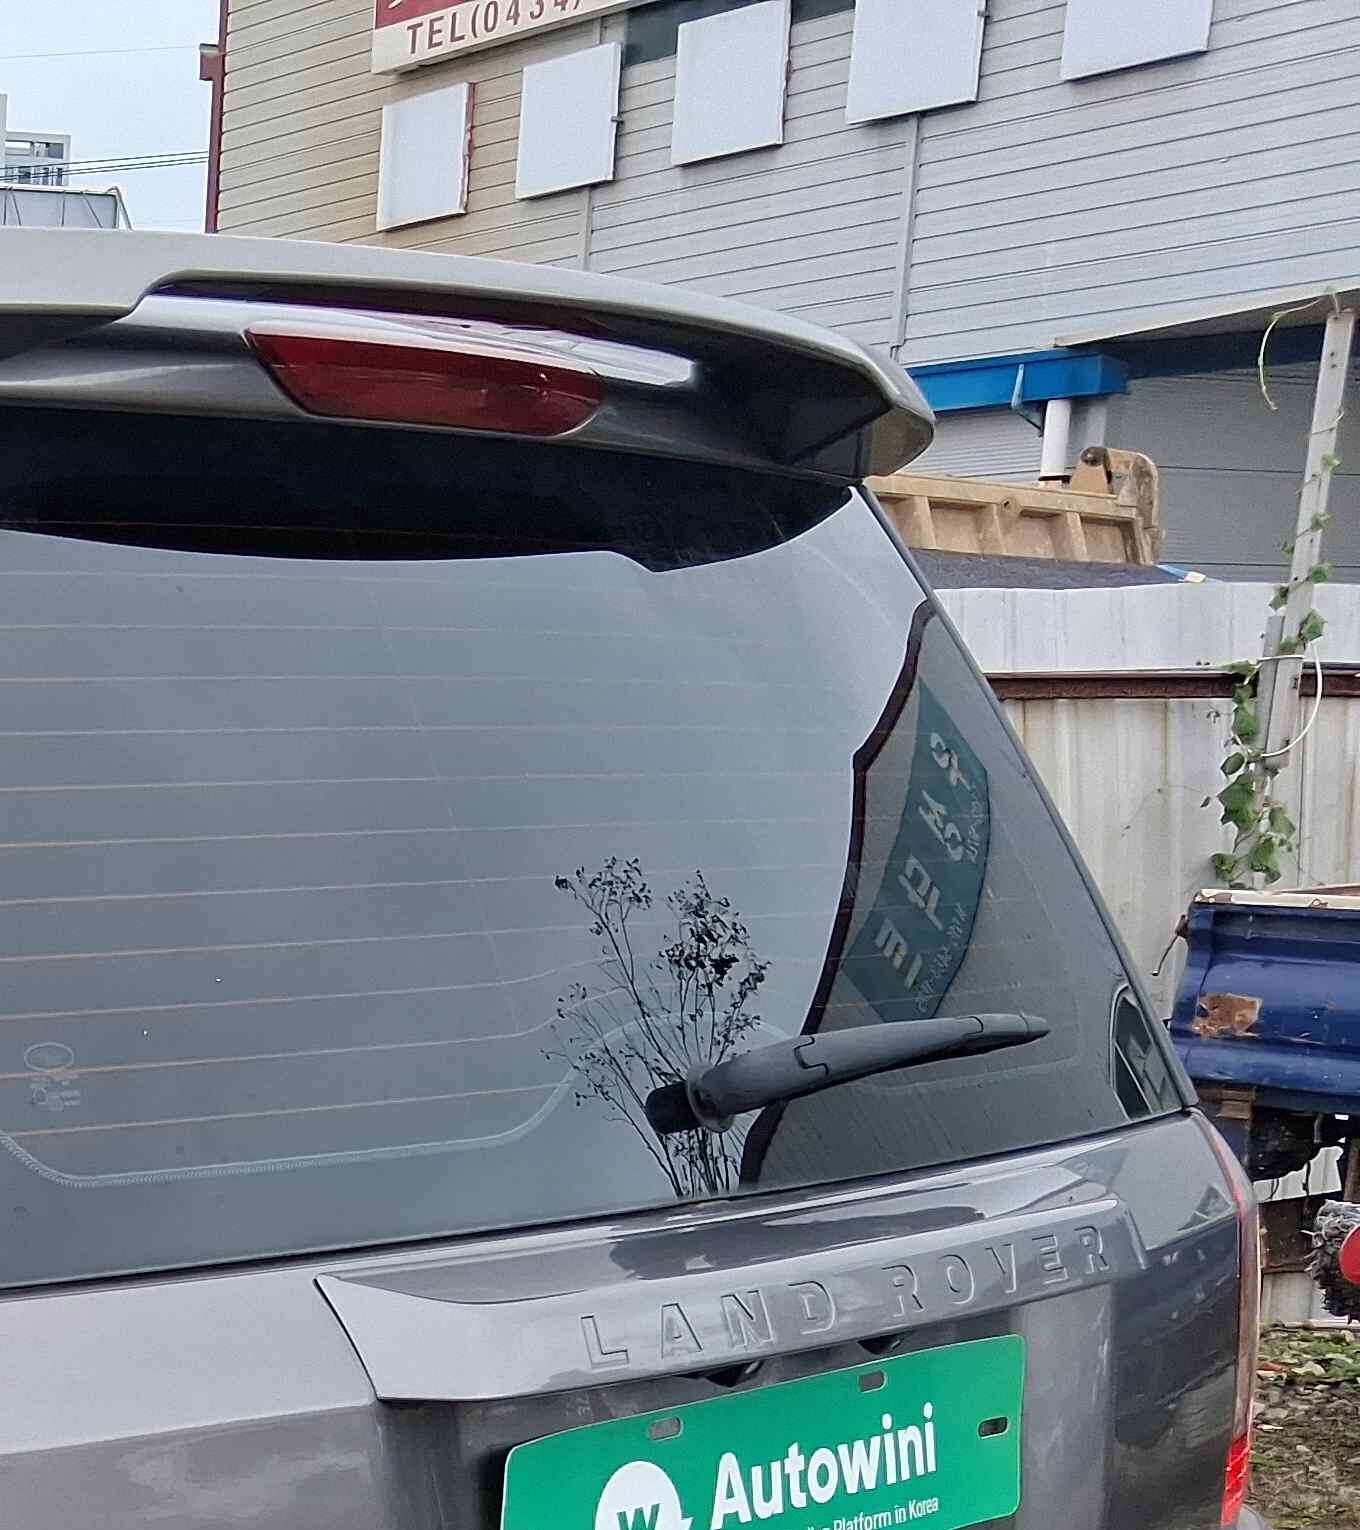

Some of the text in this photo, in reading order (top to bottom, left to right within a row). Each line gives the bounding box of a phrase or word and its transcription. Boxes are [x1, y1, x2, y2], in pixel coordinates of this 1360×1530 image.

[580, 1225, 1111, 1370] LAND ROVER
[895, 1504, 907, 1526] in
[909, 1496, 939, 1521] Korea
